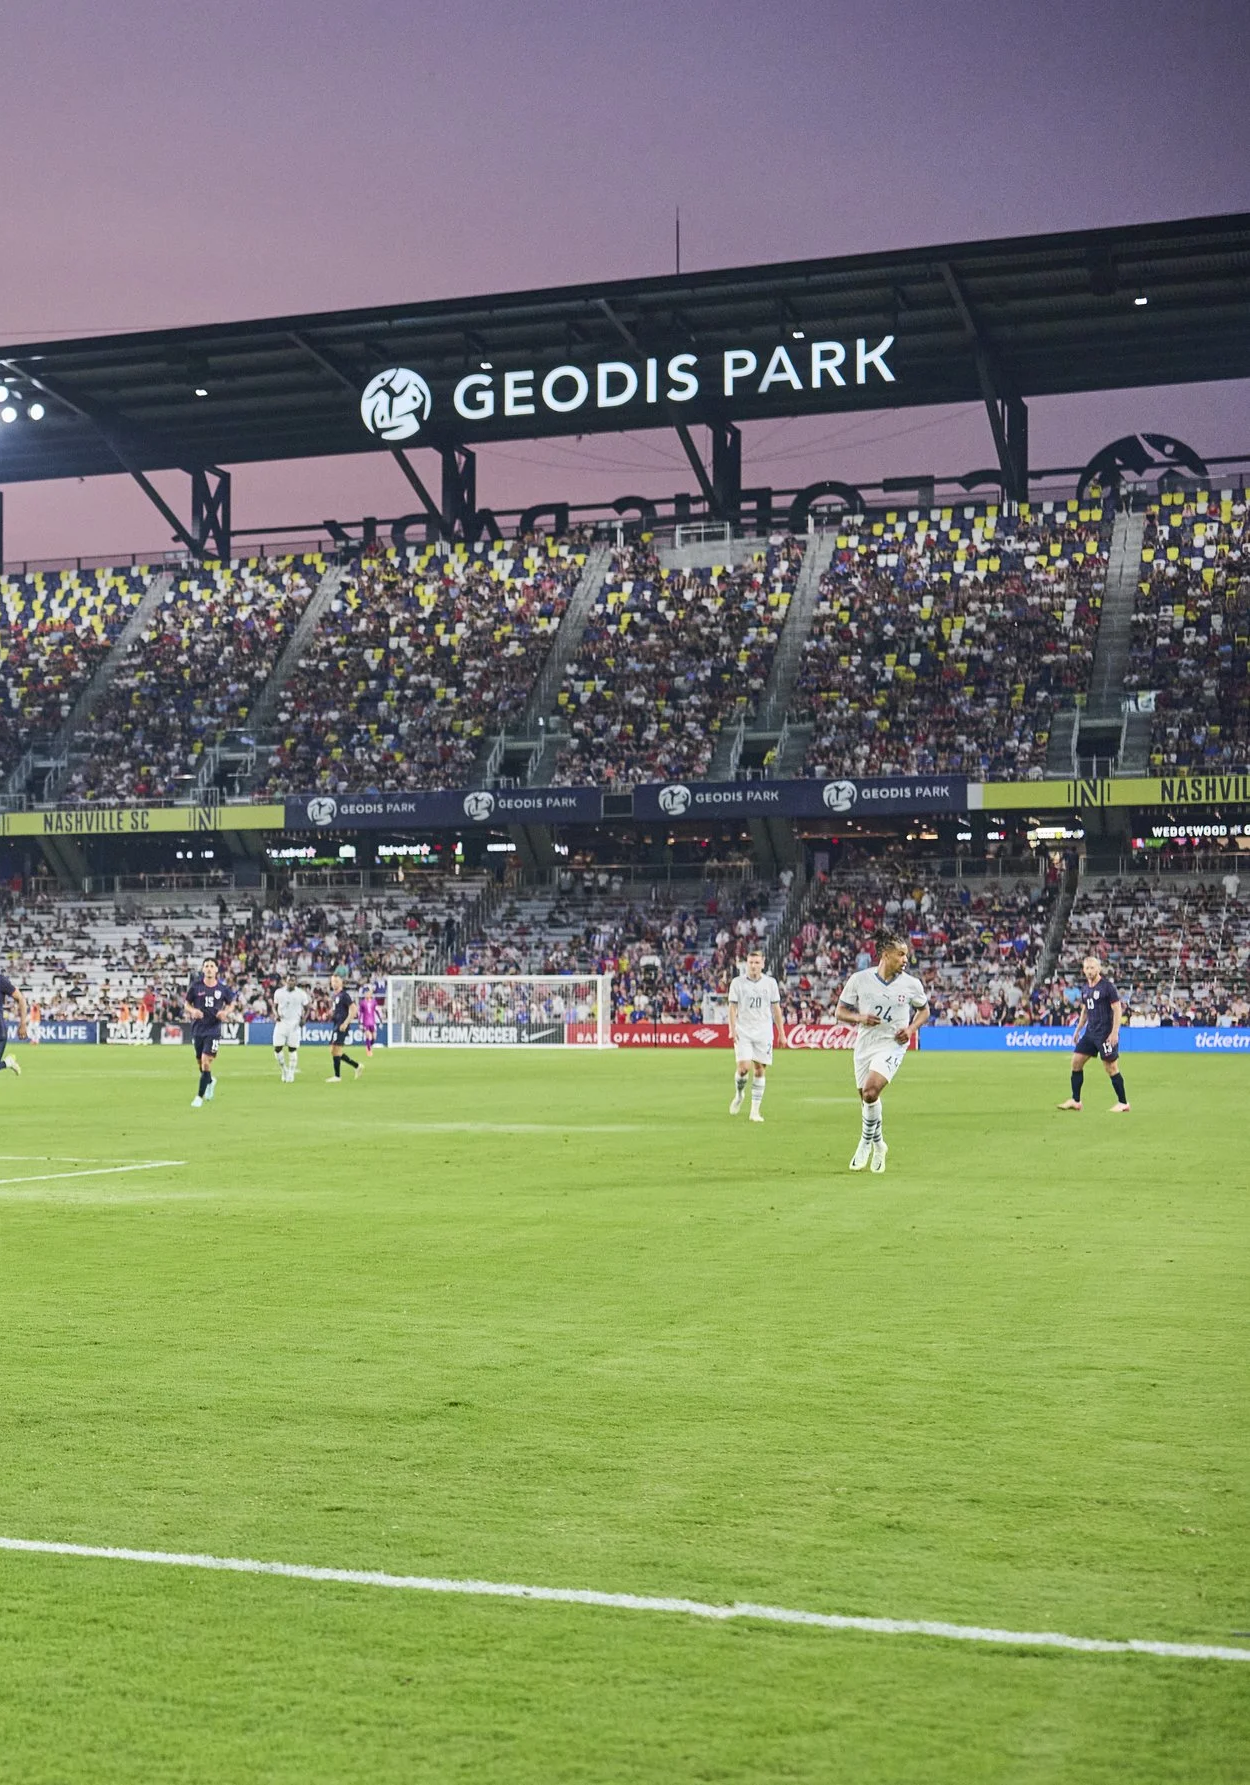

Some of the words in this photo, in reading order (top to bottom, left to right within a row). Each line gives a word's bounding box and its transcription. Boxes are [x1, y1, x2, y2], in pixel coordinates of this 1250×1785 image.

[452, 353, 700, 420] GEODIS
[723, 335, 896, 397] PARK
[695, 791, 743, 804] GEODIS
[746, 790, 779, 801] PARK
[861, 787, 911, 800] GEODIS
[915, 786, 950, 797] PARK
[340, 804, 383, 815] GEODIS
[387, 802, 416, 813] PARK
[499, 798, 543, 809] GEODIS
[546, 797, 577, 808] PARK
[43, 811, 124, 833] NASHVILLE
[130, 811, 149, 830] SC
[205, 996, 214, 1008] 15
[749, 996, 762, 1009] 20
[1086, 998, 1094, 1010] 13
[875, 1005, 893, 1022] 24
[58, 1025, 87, 1040] LIFE
[411, 1026, 517, 1043] NIKE.COM/SOCCER
[613, 1032, 630, 1044] OF
[631, 1032, 690, 1044] AMERICA
